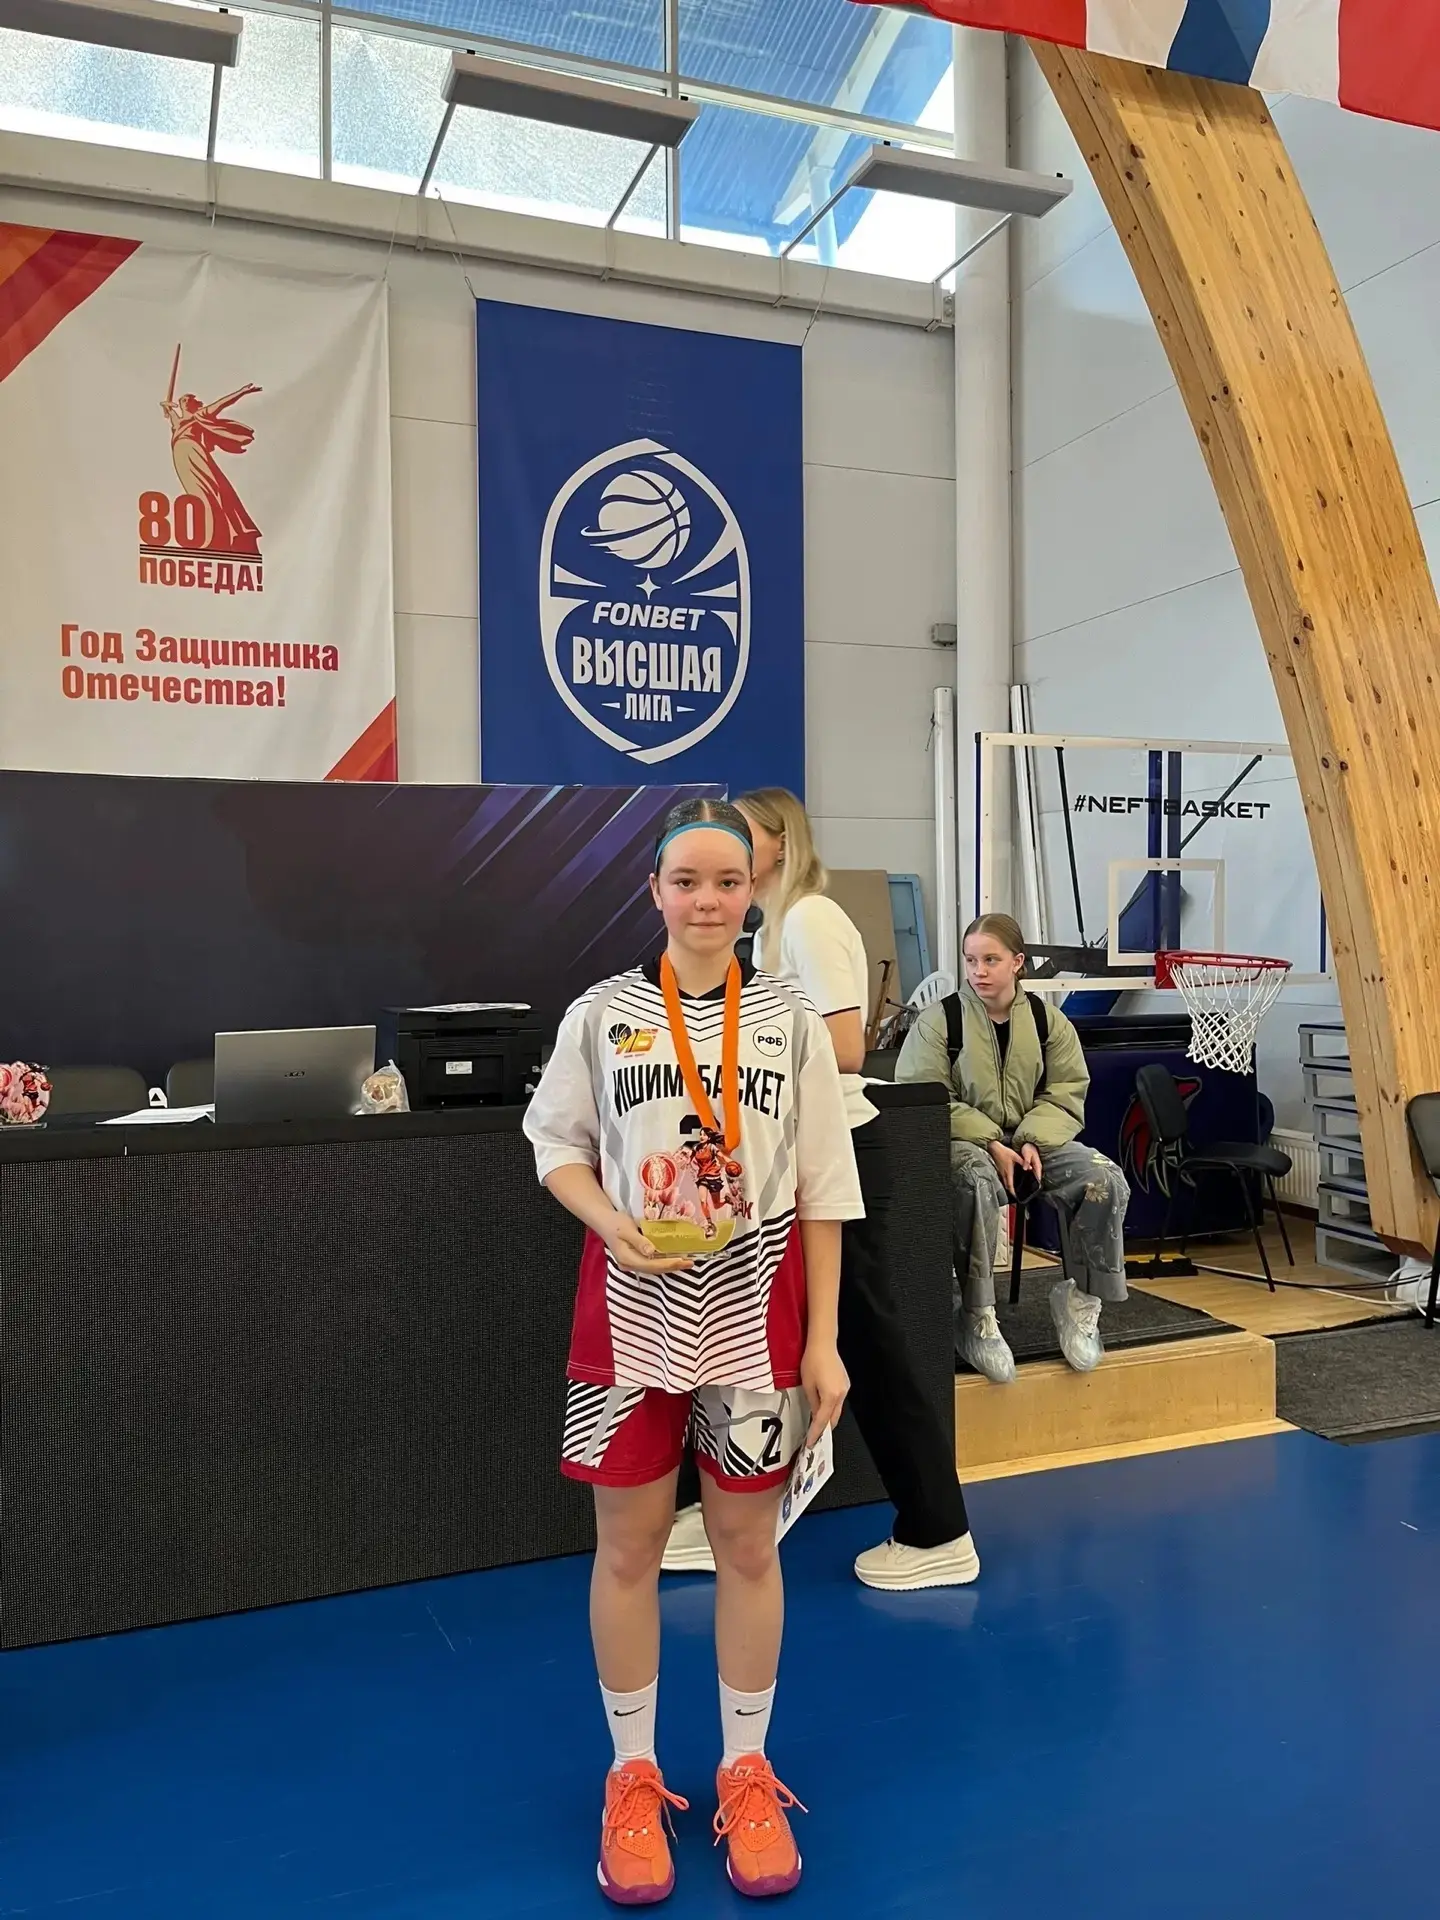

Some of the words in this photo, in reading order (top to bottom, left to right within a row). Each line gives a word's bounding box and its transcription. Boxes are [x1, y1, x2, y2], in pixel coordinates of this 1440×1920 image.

[139, 491, 206, 548] 80
[139, 557, 264, 594] ПОБЕДА!
[592, 602, 706, 631] FONBET
[61, 624, 124, 664] Год
[135, 628, 339, 671] Защитника
[572, 636, 721, 693] ВЫСШАЯ
[62, 665, 287, 707] Отечества!
[624, 693, 673, 722] ЛИГА
[757, 1035, 783, 1047] РФБ
[612, 1063, 684, 1118] ИШИМ
[761, 1416, 783, 1468] 2
